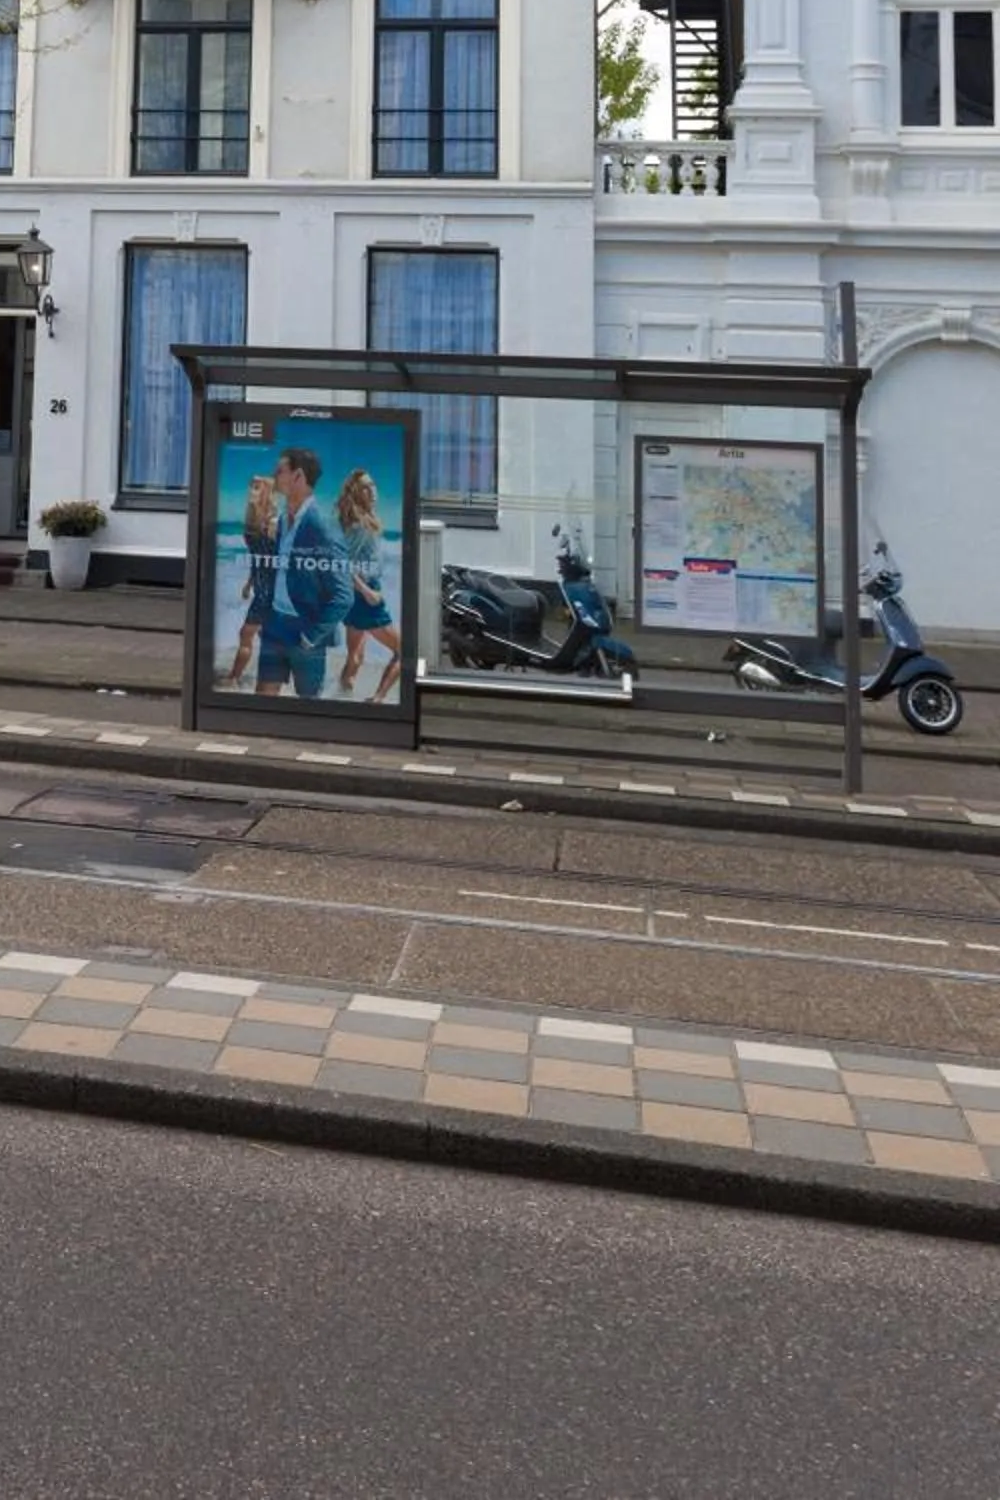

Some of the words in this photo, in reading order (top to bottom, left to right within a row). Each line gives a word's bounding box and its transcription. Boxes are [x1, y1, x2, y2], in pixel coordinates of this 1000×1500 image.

[50, 399, 67, 414] 26
[233, 421, 263, 438] WE
[294, 556, 381, 576] TOGETHER
